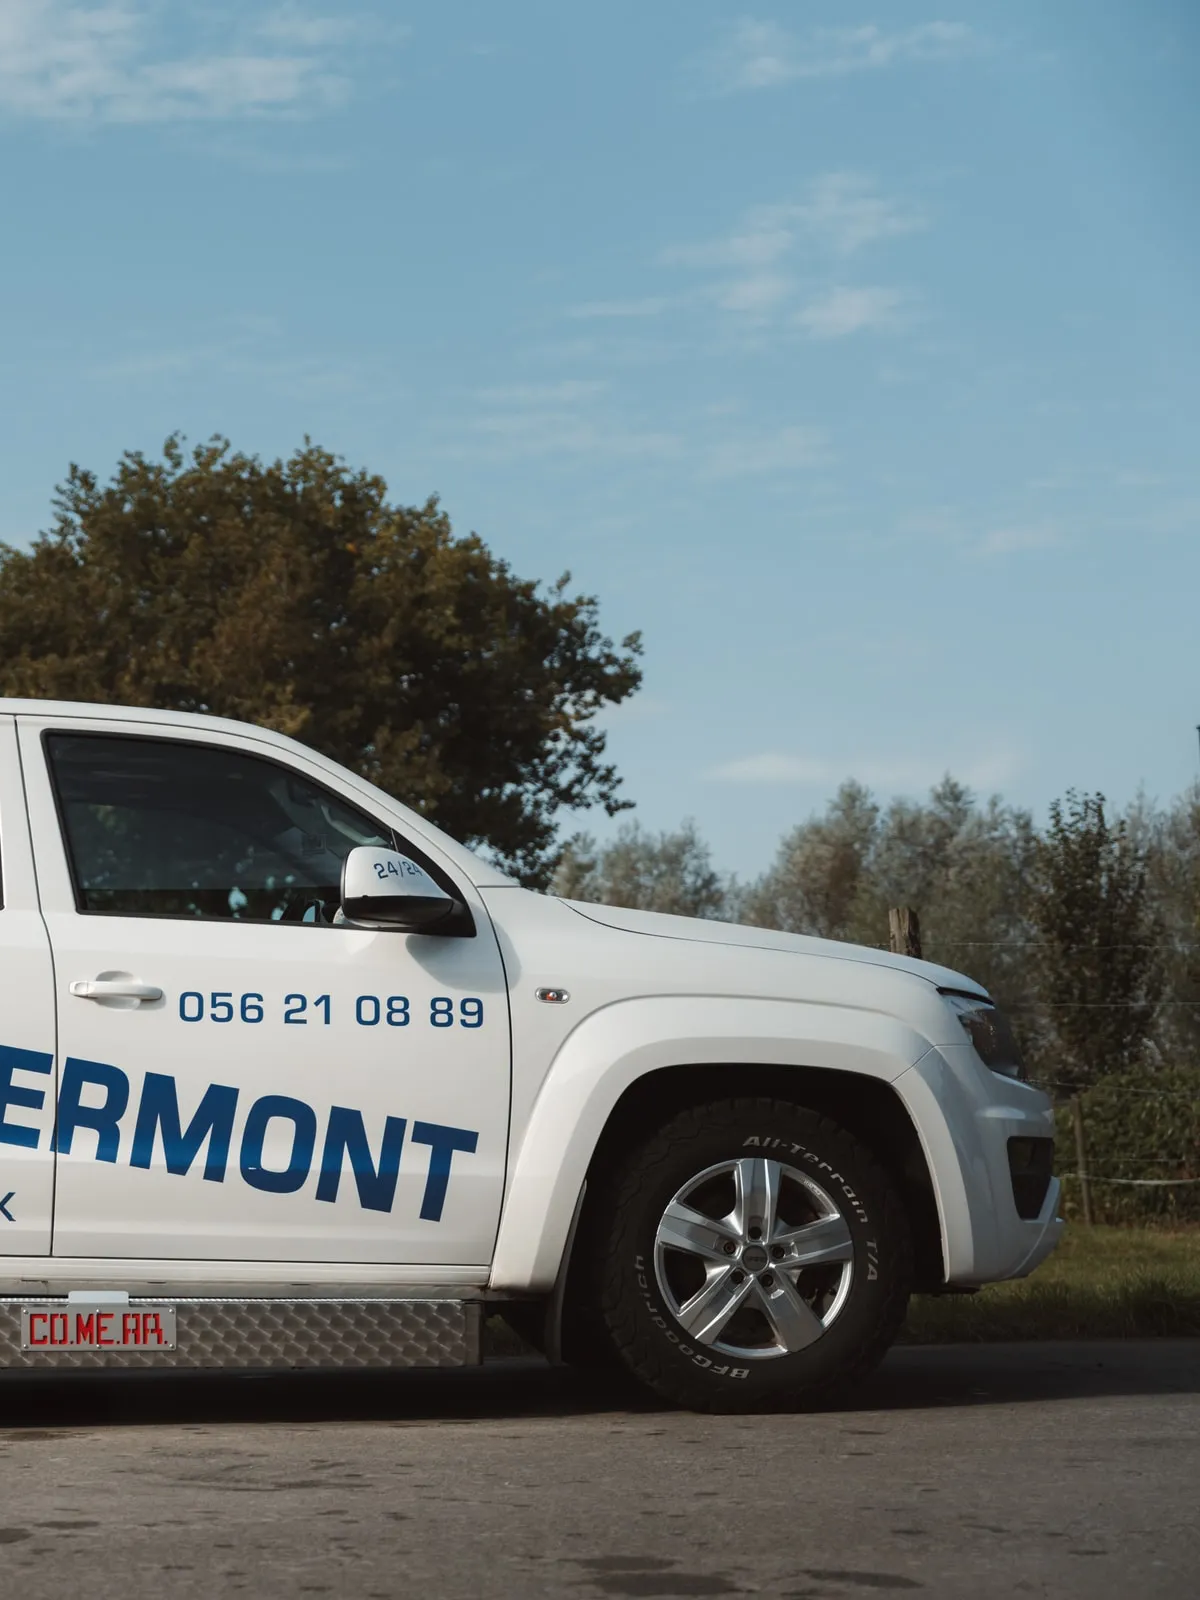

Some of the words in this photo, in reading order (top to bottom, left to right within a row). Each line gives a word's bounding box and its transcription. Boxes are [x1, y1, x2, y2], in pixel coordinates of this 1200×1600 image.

[179, 991, 264, 1023] 056
[284, 993, 331, 1025] 21
[356, 995, 410, 1027] 08
[430, 997, 484, 1028] 89
[742, 1135, 869, 1223] All-Terrain
[634, 1255, 750, 1379] BFGoodrich
